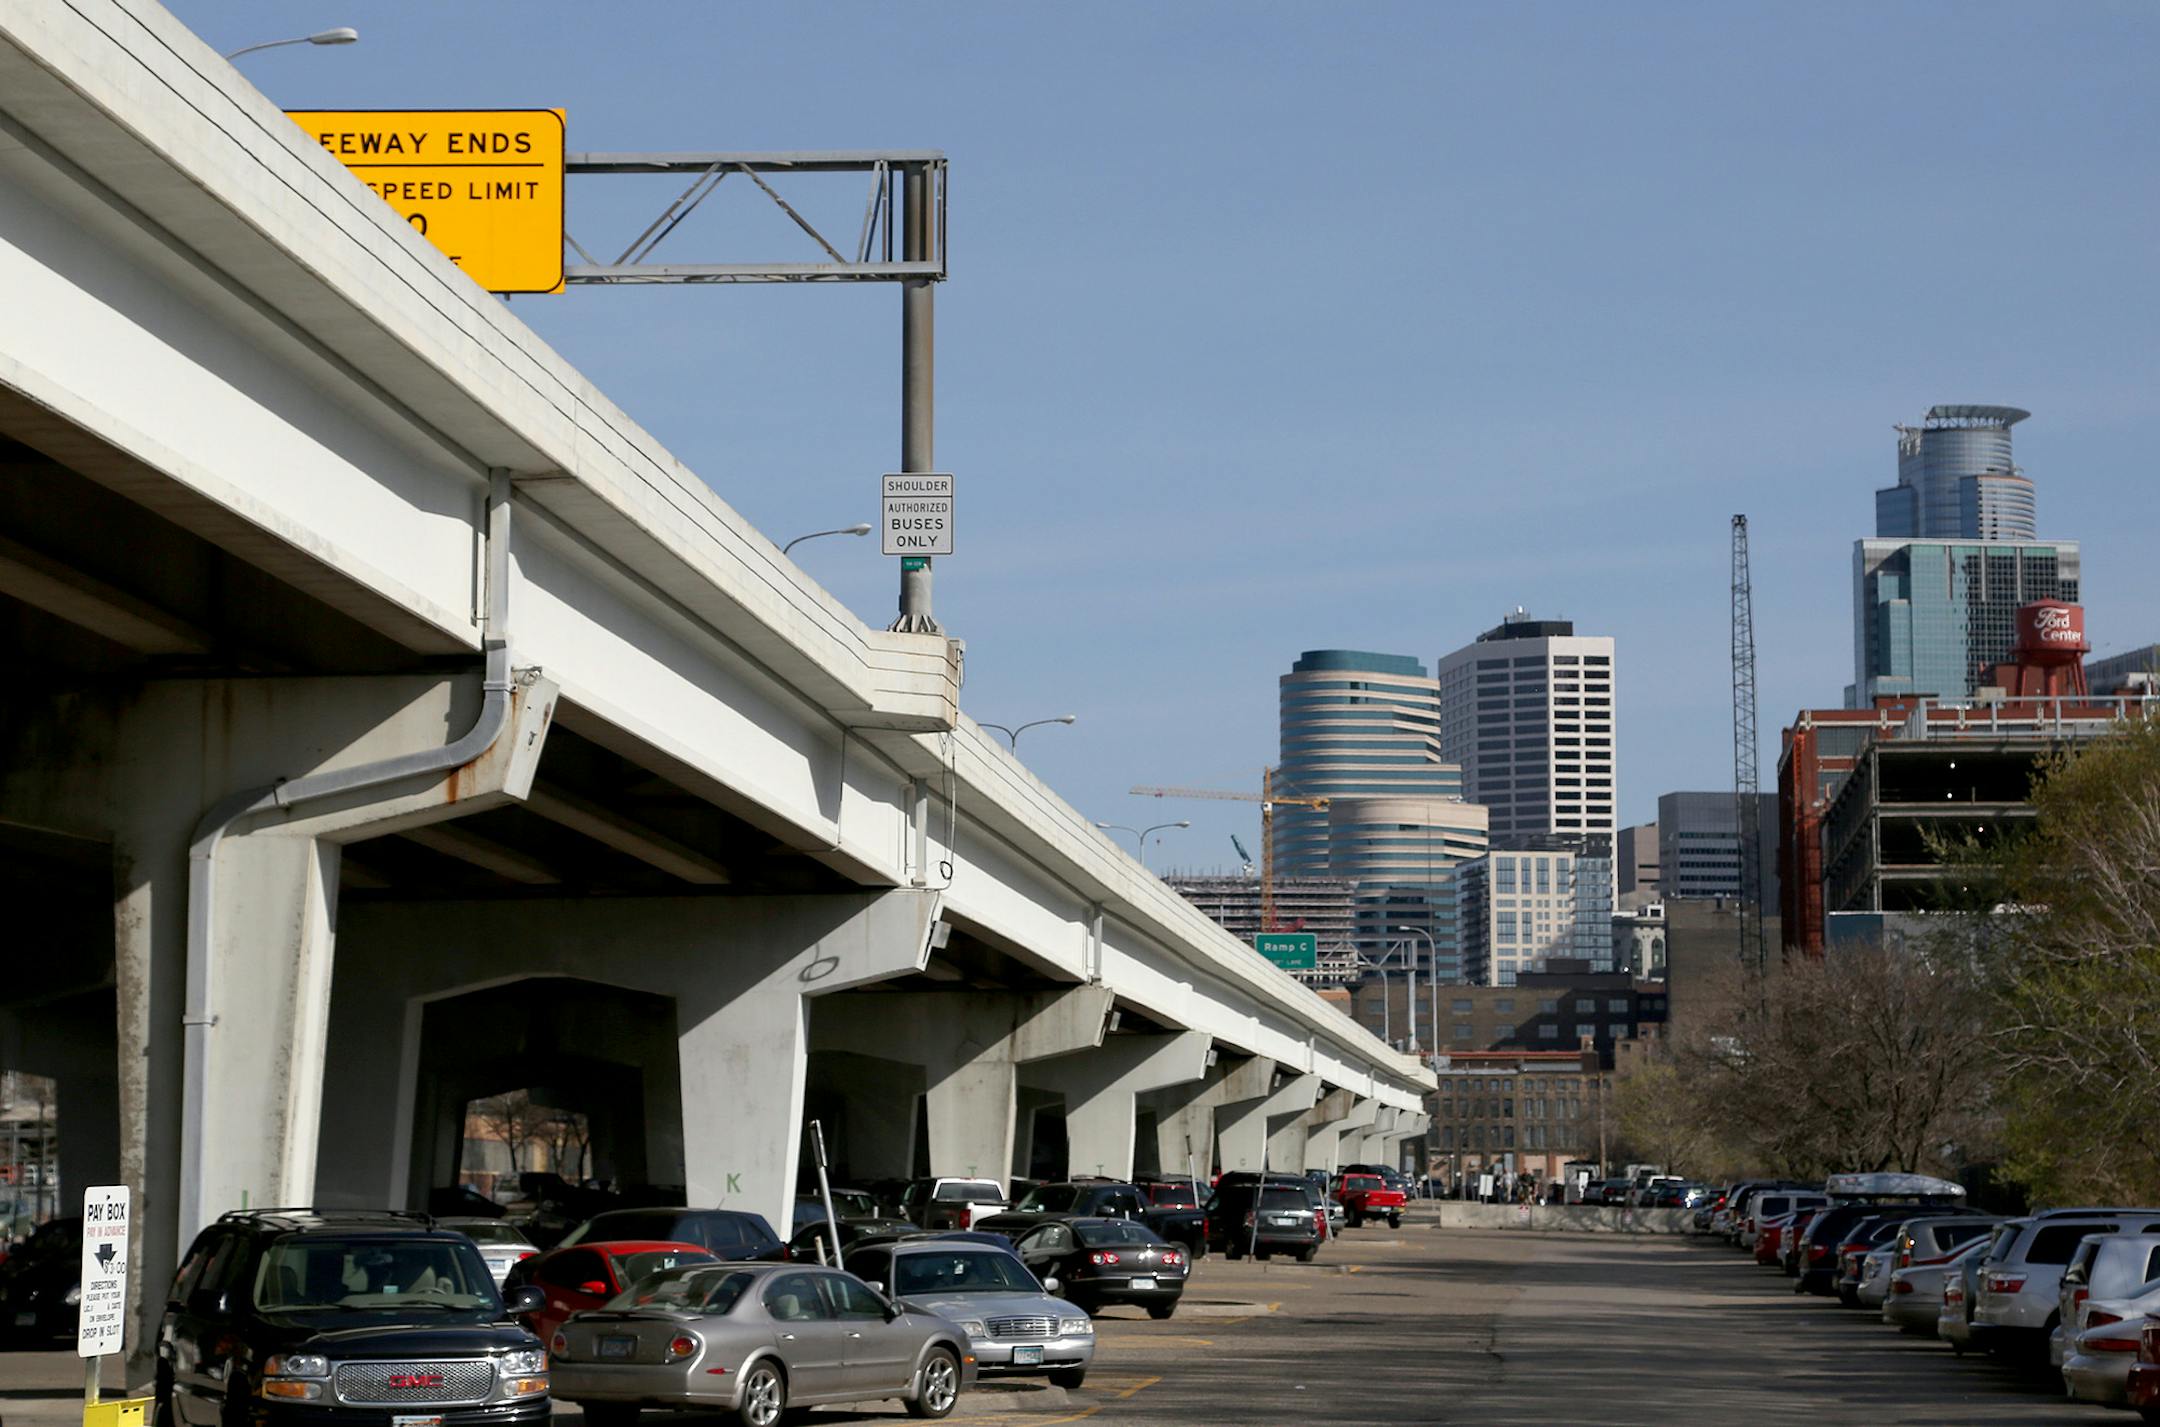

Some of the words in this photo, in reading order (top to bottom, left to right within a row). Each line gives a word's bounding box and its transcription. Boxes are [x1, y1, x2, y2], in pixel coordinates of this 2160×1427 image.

[448, 133, 532, 153] ENDS
[469, 182, 539, 200] LIMIT
[888, 481, 948, 491] SHOULDER
[888, 503, 948, 512] AUTHORIZED
[891, 518, 944, 530] BUSES
[896, 535, 938, 547] ONLY
[2034, 607, 2070, 628] Ford
[2041, 628, 2081, 642] Center
[1264, 942, 1295, 952] Ramp
[1300, 942, 1307, 951] C
[727, 1173, 741, 1193] K
[88, 1204, 104, 1221] PAY
[108, 1203, 126, 1220] BOX
[90, 1280, 118, 1290] DIRECTIONS
[82, 1327, 97, 1339] DROP
[99, 1327, 105, 1337] IN
[106, 1324, 120, 1336] SLOT
[389, 1375, 445, 1388] GMC
